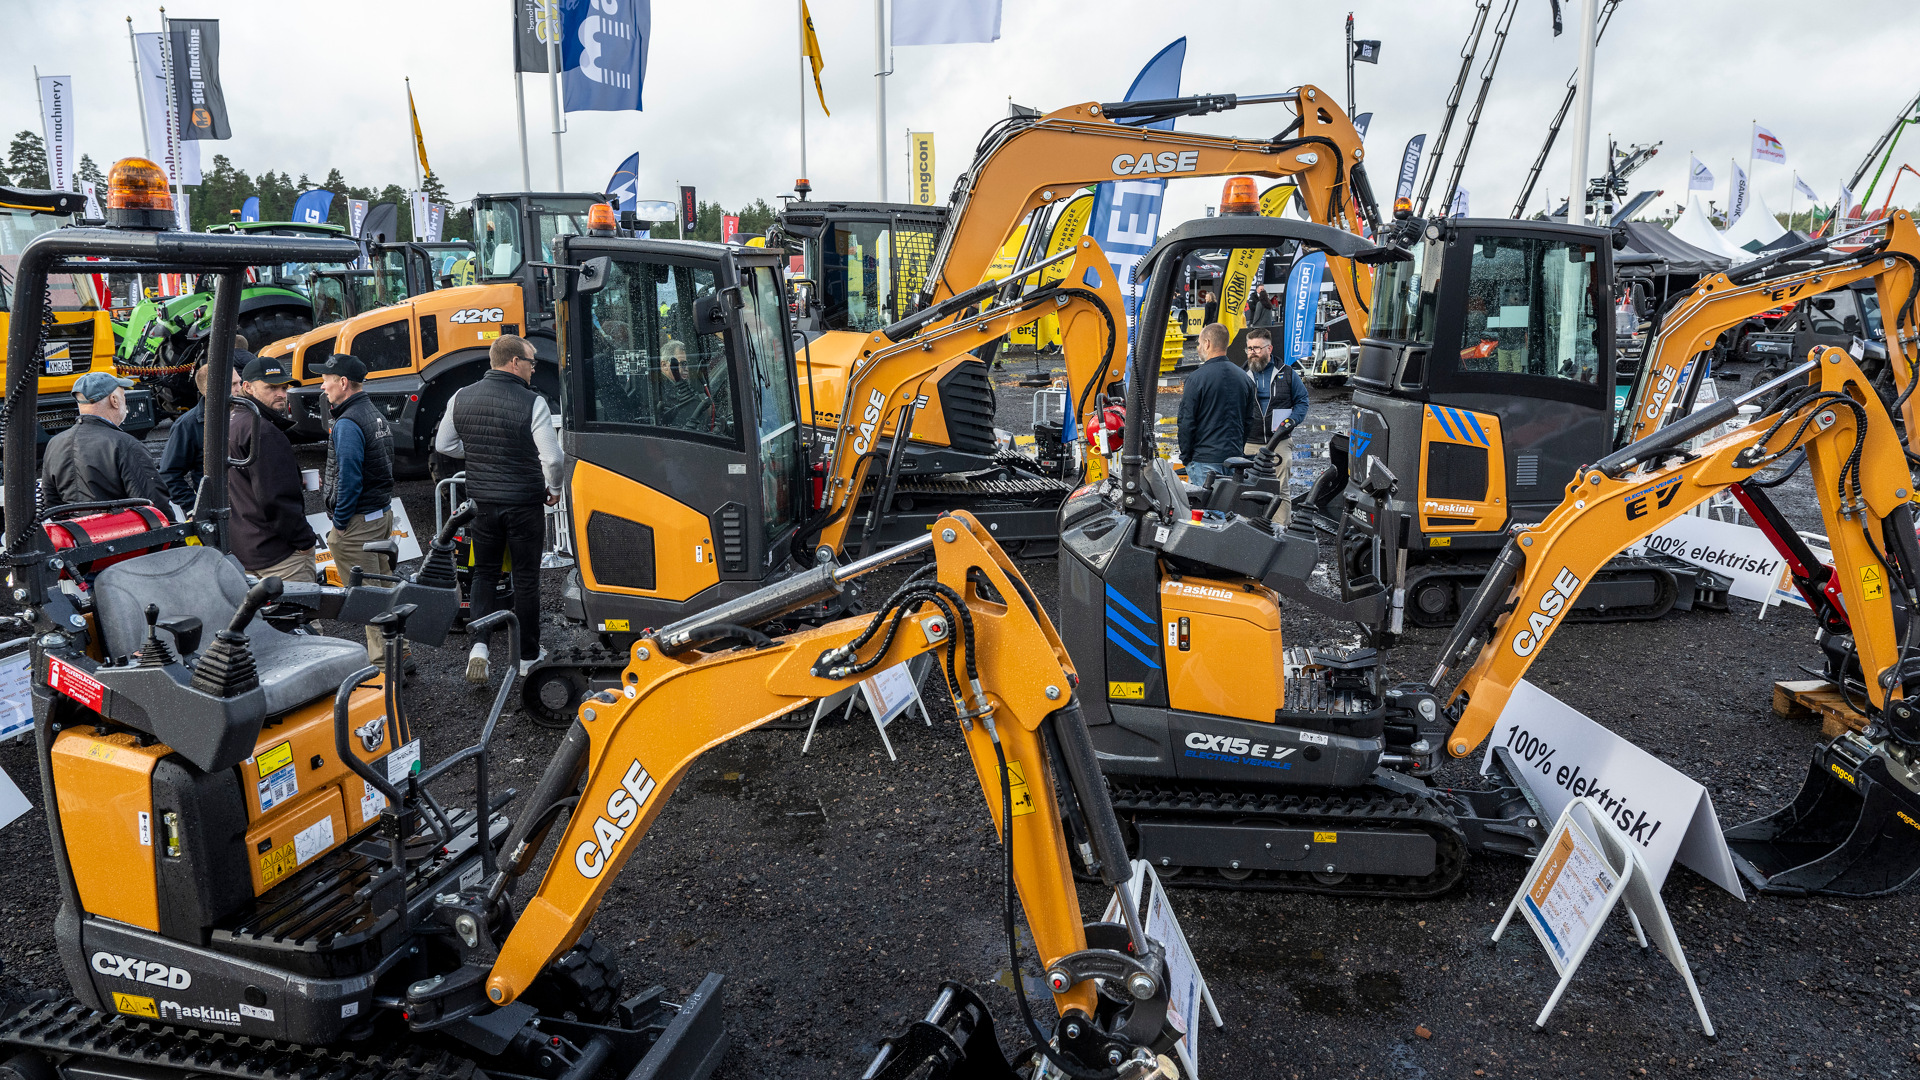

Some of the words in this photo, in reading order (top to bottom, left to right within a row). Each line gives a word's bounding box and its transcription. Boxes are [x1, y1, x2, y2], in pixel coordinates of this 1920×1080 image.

[188, 28, 203, 80] Machine
[51, 80, 64, 142] machinery
[191, 81, 205, 104] Stig
[919, 139, 929, 204] engcon
[1111, 150, 1199, 176] CASE
[1401, 141, 1421, 182] NORJE
[1733, 179, 1747, 217] SANDVIK
[1227, 274, 1246, 314] ASTRAK
[1297, 266, 1312, 310] MOTOR
[450, 307, 504, 324] 421G
[1646, 364, 1677, 419] CASE
[853, 387, 887, 455] CASE
[1423, 501, 1475, 514] Maskinia
[1624, 486, 1655, 502] ELECTRIC
[1655, 474, 1683, 489] VEHICLE
[1352, 508, 1368, 523] ASE
[1643, 533, 1688, 557] 100%
[1690, 545, 1780, 576] elektrisk!
[1162, 580, 1234, 600] Maskinia
[1512, 566, 1581, 658] CASE
[1184, 732, 1251, 755] CX15
[1184, 749, 1240, 763] ELECTRIC
[1242, 756, 1293, 770] VEHICLE
[1506, 724, 1556, 775] 100%
[1556, 765, 1662, 848] elektrisk!
[575, 757, 657, 879] CASE
[1535, 860, 1558, 899] CX15EV
[1599, 871, 1613, 891] CASE
[91, 951, 192, 991] CX12D
[160, 1000, 241, 1022] Maskinia
